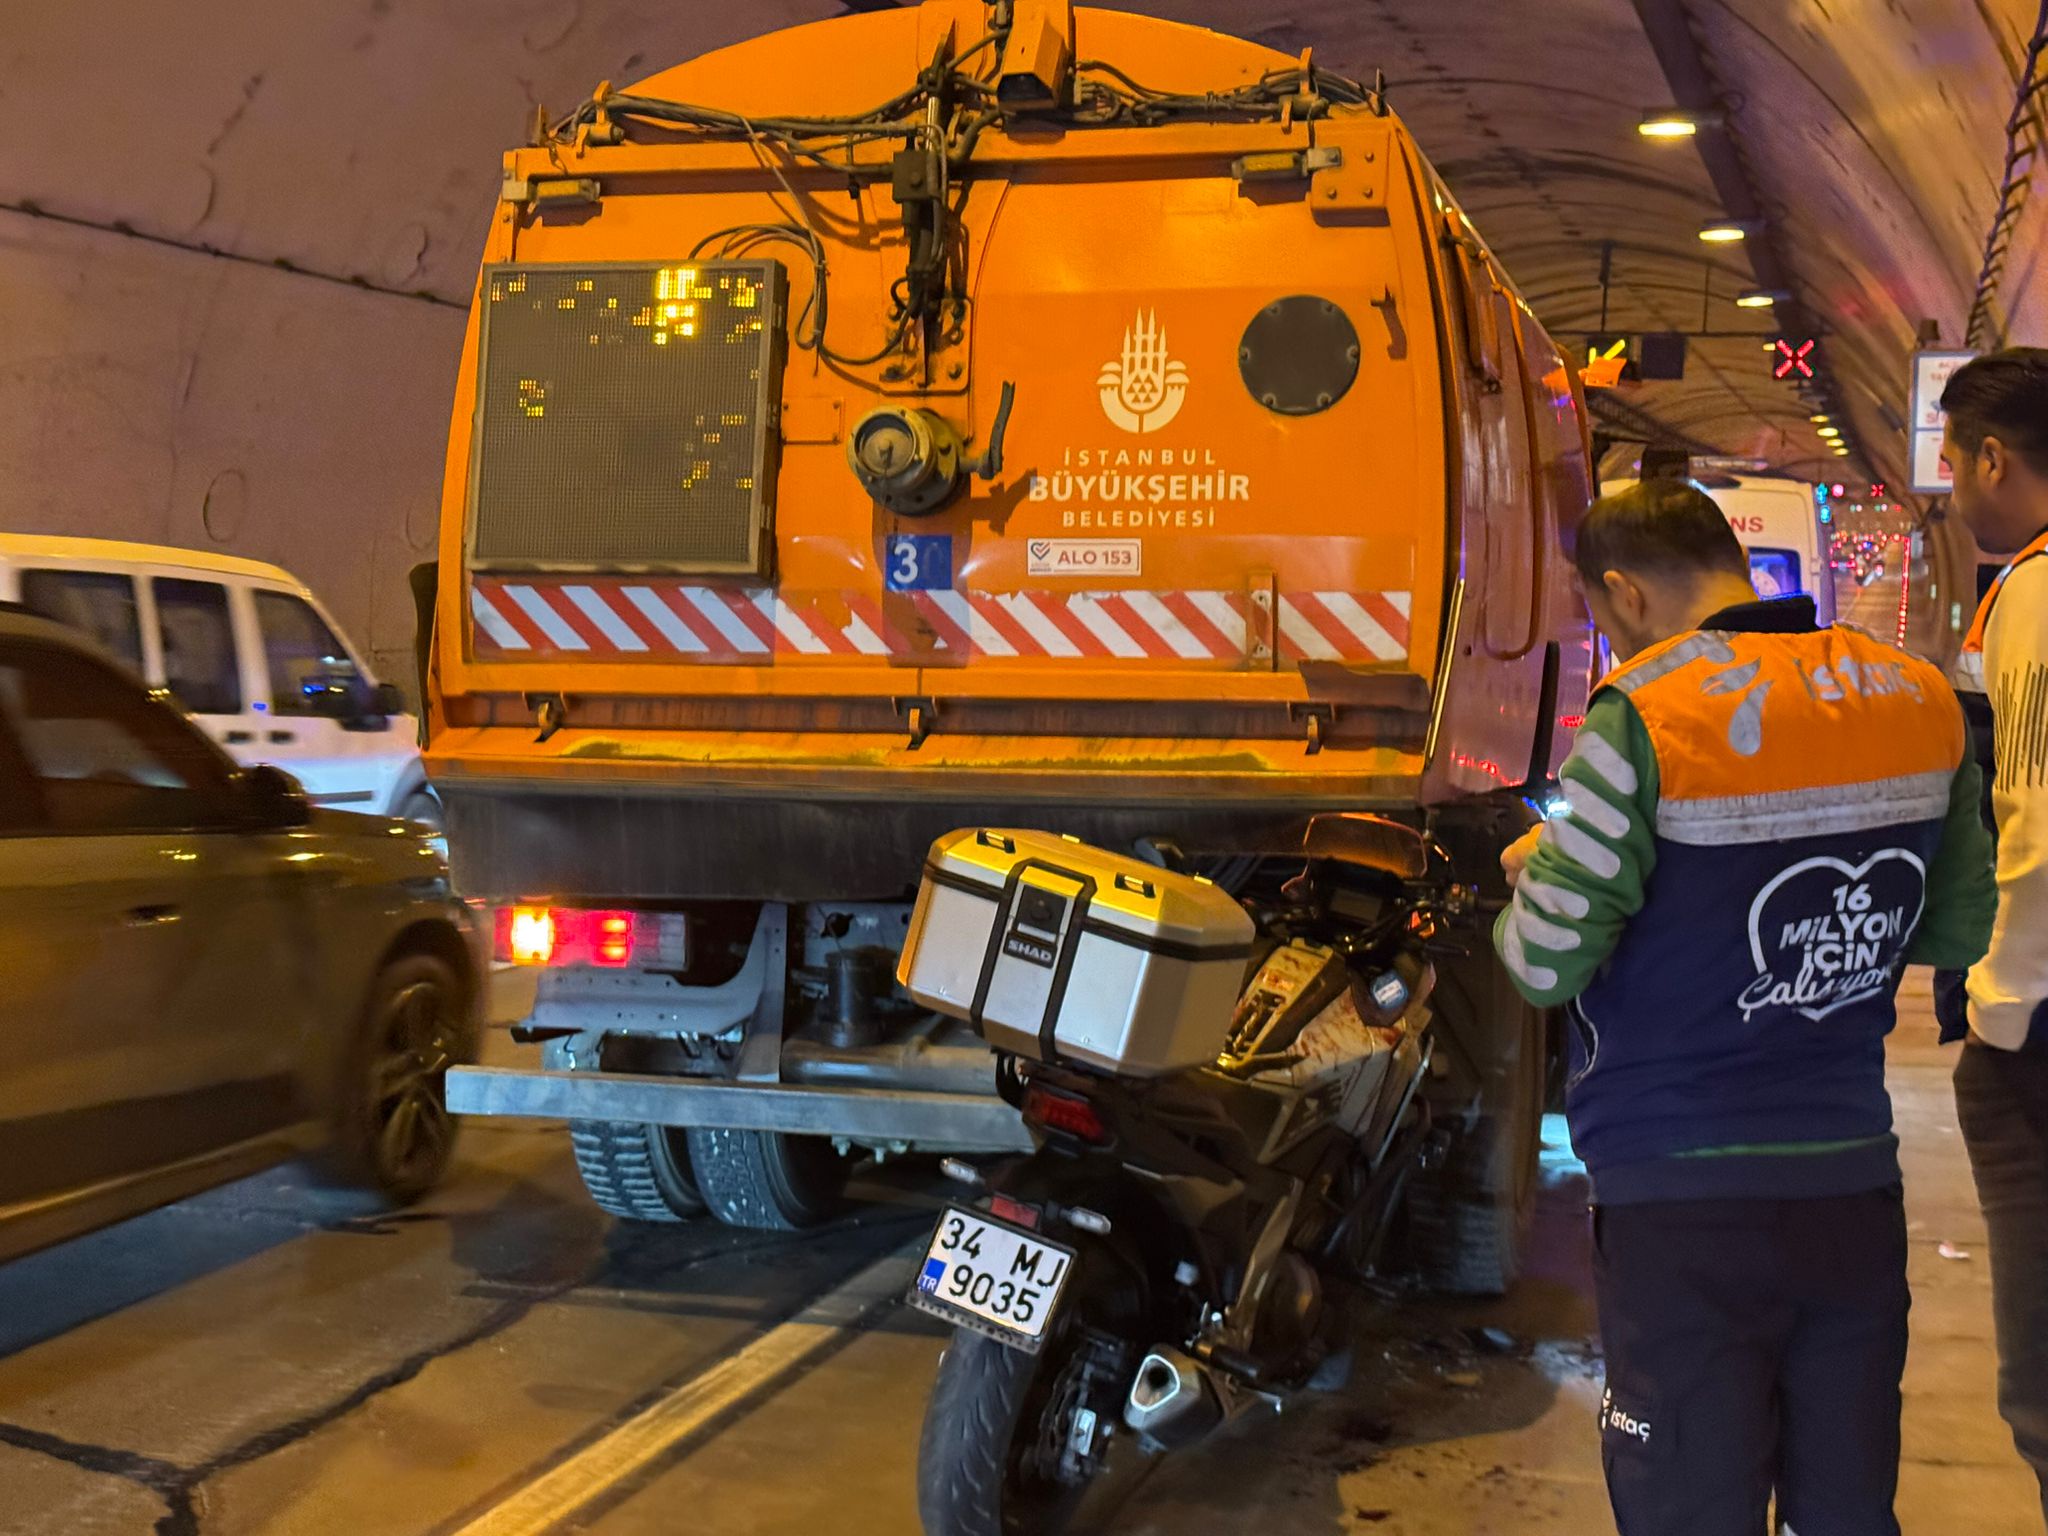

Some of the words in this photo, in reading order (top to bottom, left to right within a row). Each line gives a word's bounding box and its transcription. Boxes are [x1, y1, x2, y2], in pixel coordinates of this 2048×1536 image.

[1064, 447, 1216, 466] İSTANBUL
[1029, 469, 1250, 503] BÜYÜKŞEHİR
[1062, 507, 1215, 527] BELEDİYESİ
[1057, 550, 1097, 565] ALO
[1102, 550, 1131, 565] 153
[1832, 883, 1872, 912] 16
[1008, 939, 1052, 962] SHAD
[941, 1218, 986, 1260] 34
[1009, 1243, 1066, 1288] MJ
[922, 1274, 937, 1292] TR
[948, 1264, 1041, 1323] 9035
[1610, 1404, 1651, 1443] istaç
